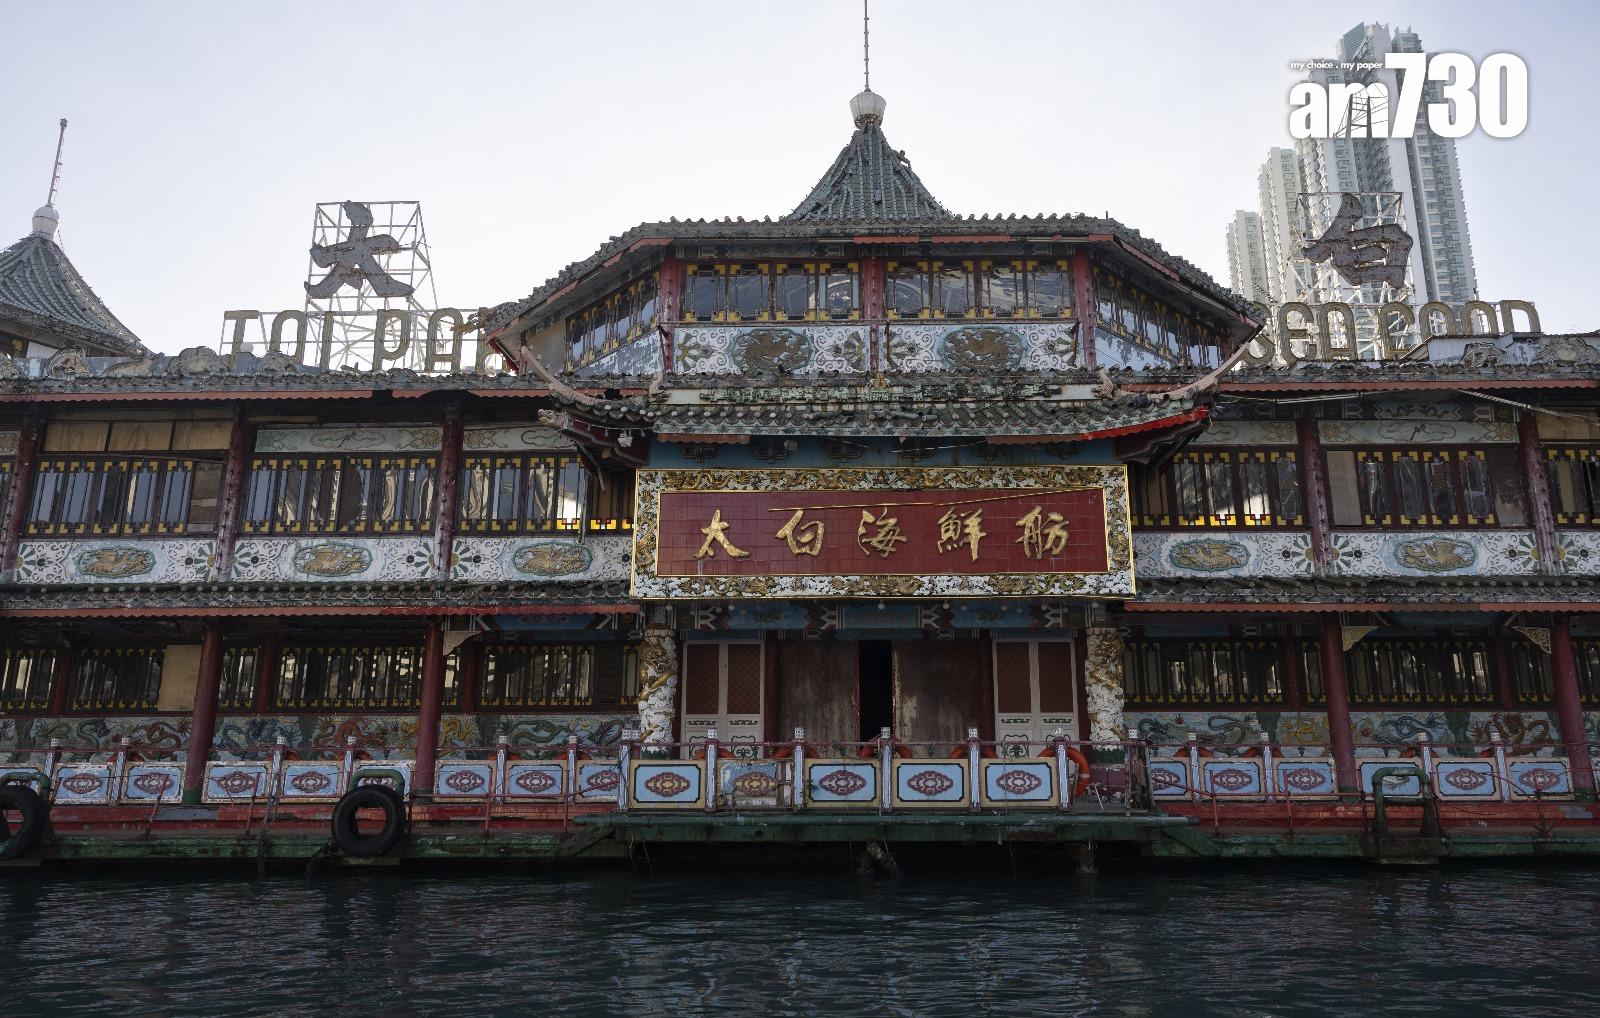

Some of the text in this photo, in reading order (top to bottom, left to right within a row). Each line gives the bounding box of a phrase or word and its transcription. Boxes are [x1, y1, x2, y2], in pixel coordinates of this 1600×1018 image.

[692, 504, 1070, 562] 太白海鮮舫
